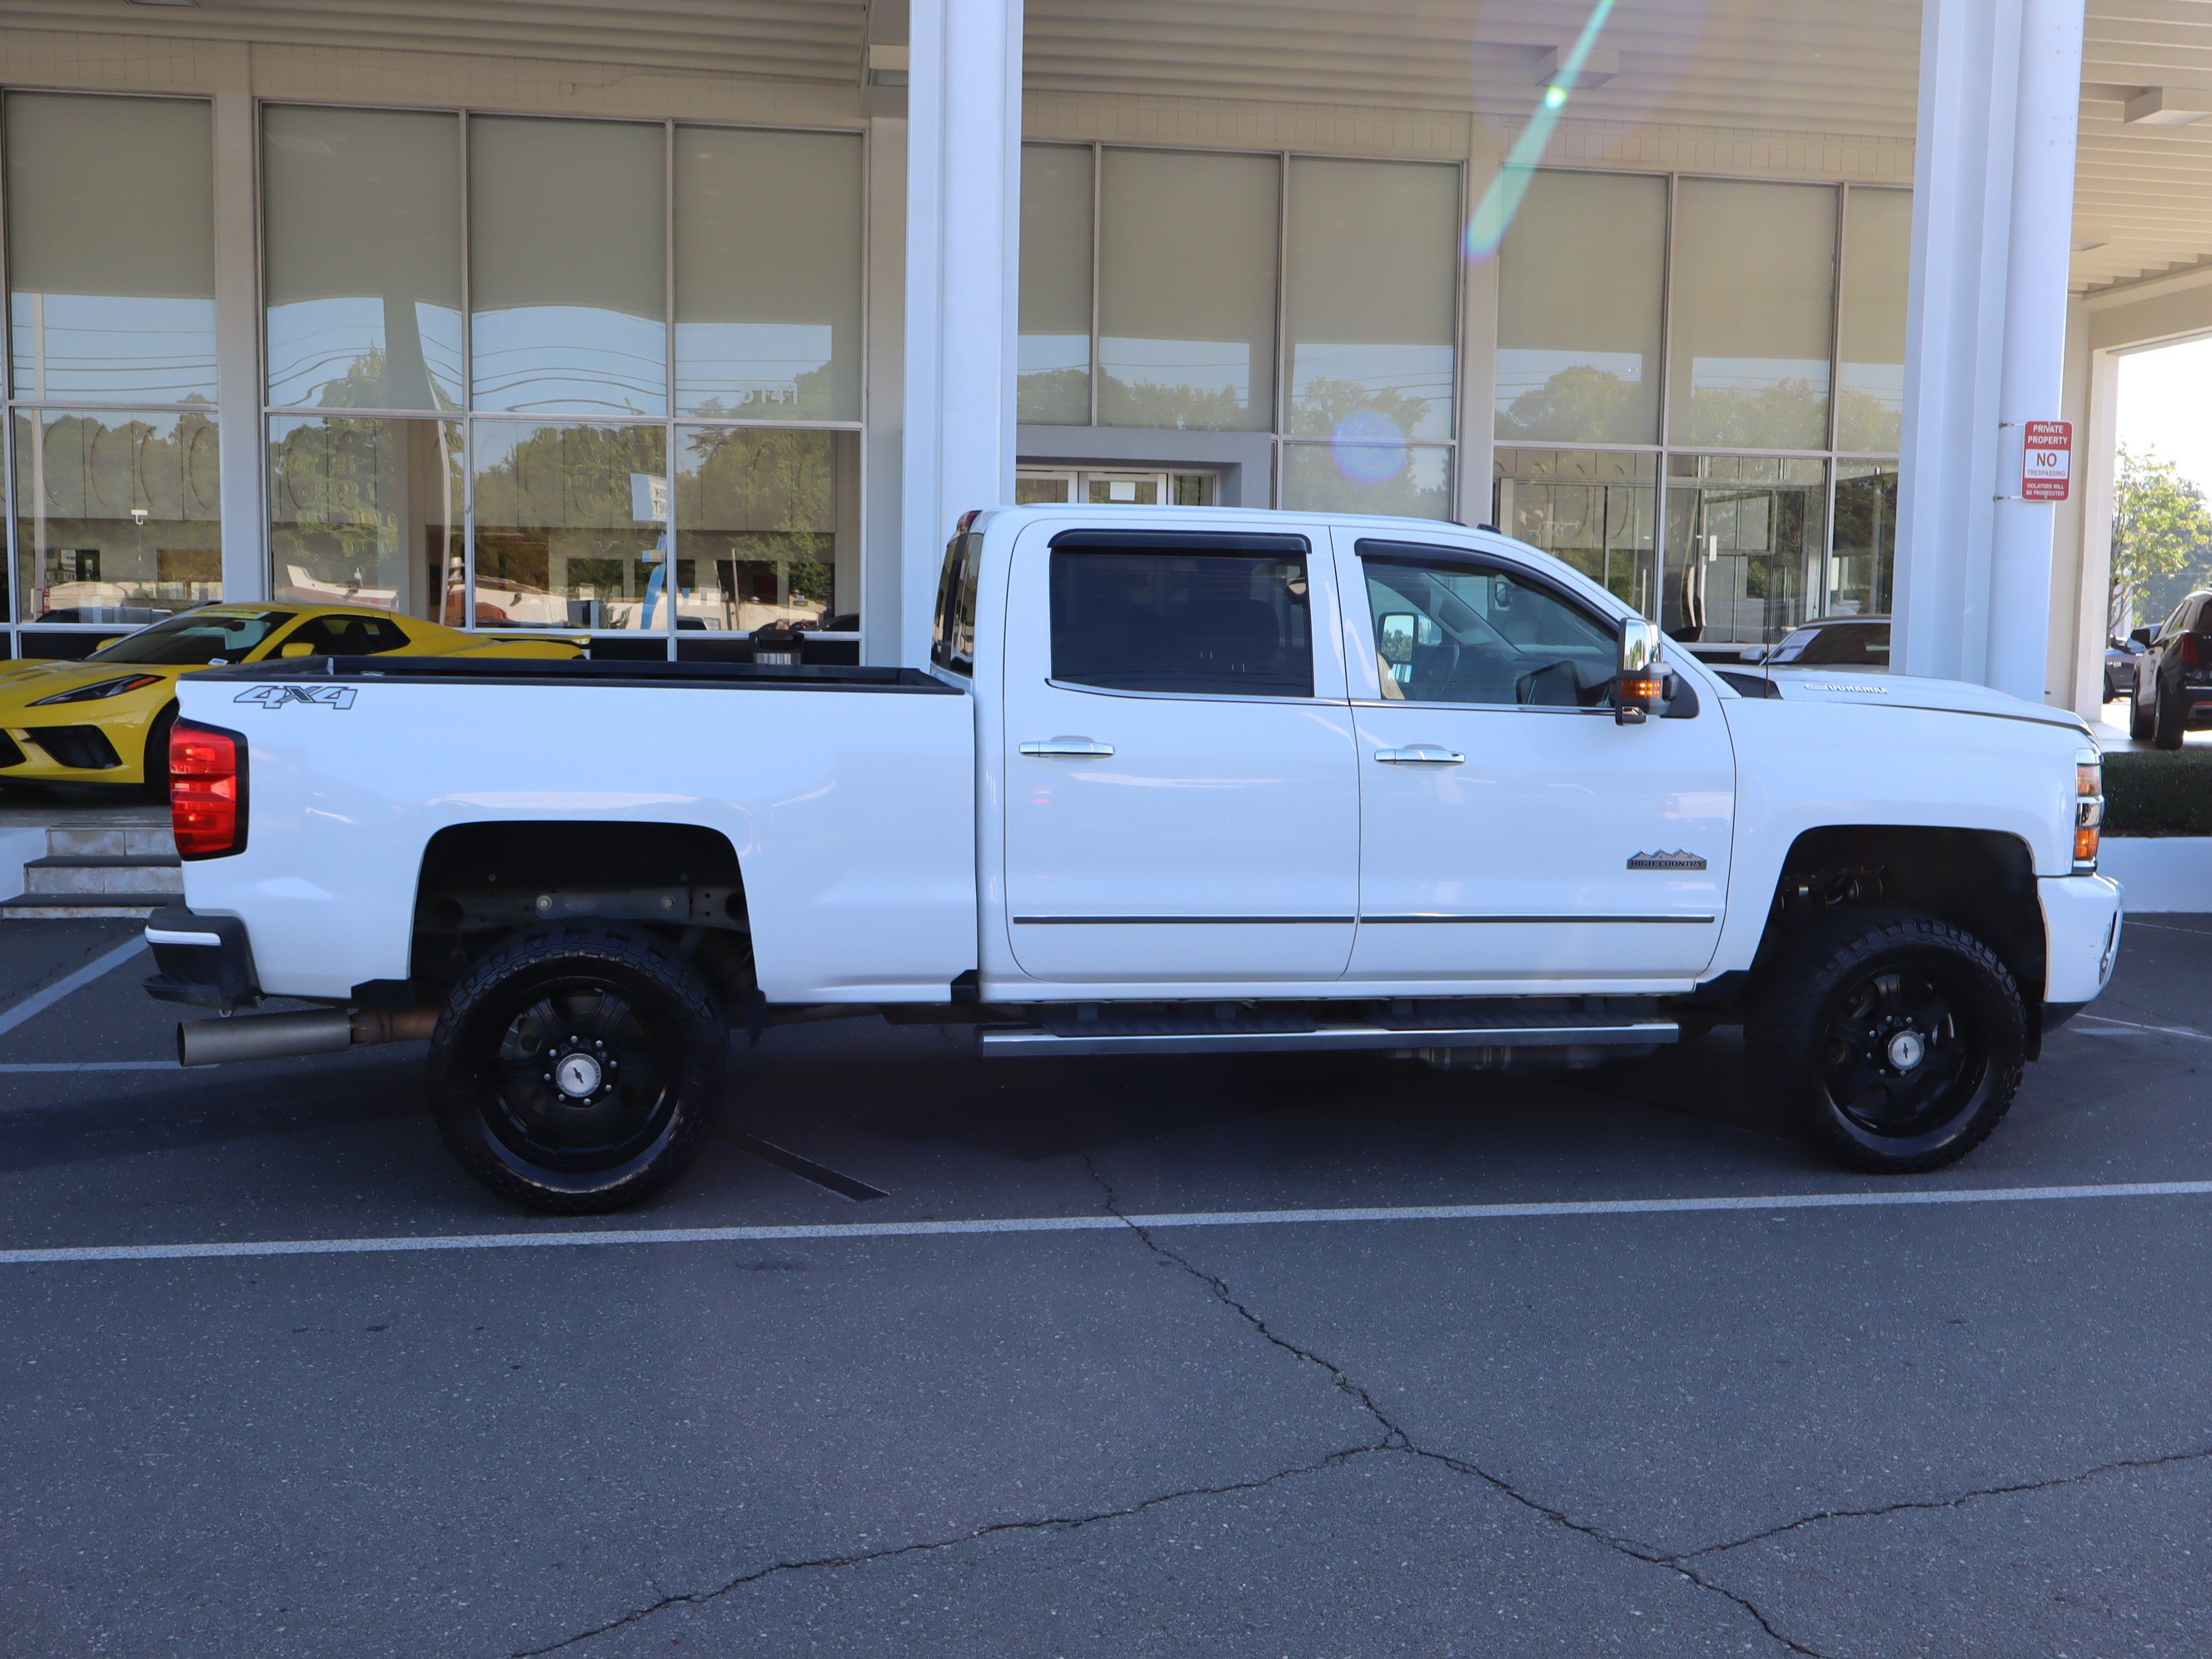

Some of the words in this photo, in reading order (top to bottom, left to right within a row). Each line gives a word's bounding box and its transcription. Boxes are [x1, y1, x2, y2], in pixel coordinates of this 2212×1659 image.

[2033, 424, 2064, 433] PRIVATE
[2027, 436, 2068, 445] PROPERTY
[2036, 452, 2057, 467] NO
